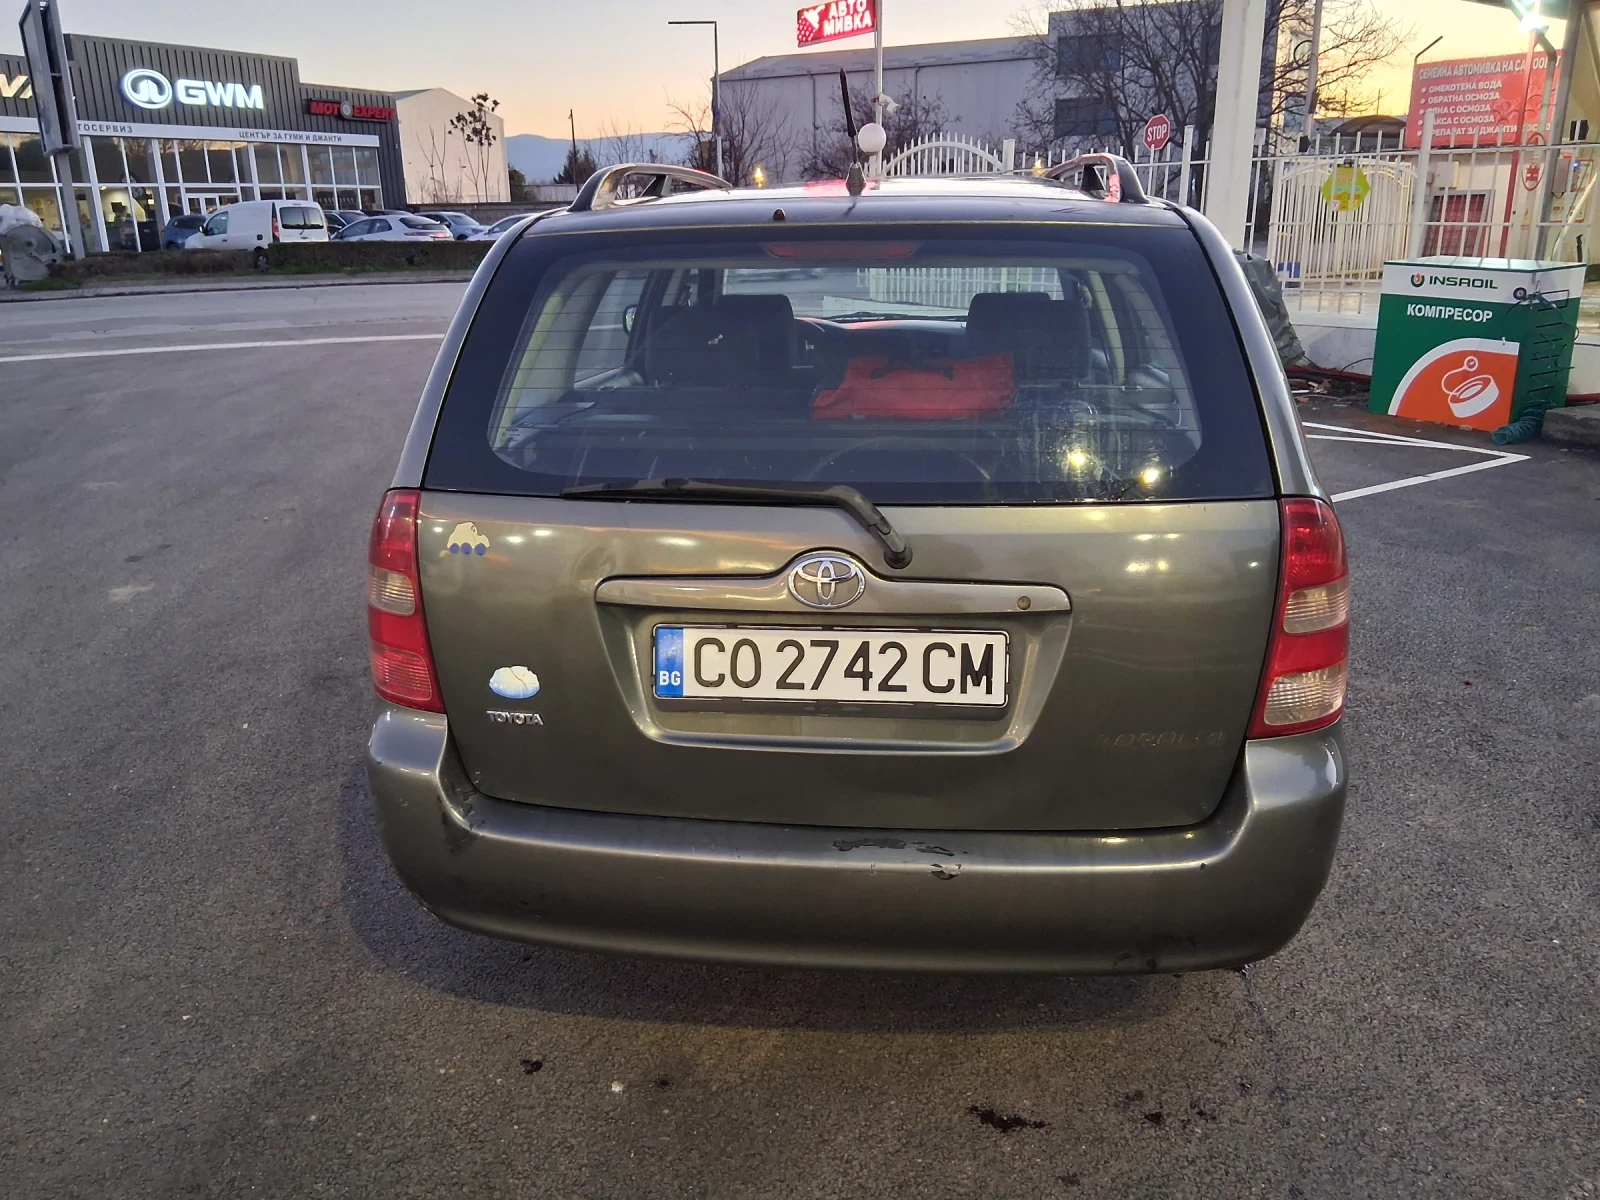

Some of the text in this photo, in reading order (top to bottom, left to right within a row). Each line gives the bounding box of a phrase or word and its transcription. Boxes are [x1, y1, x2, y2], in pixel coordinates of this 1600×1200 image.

[829, 0, 867, 19] АВТО
[823, 10, 872, 36] МИВКА
[1453, 61, 1501, 77] АВТОМИВКА
[1501, 60, 1514, 72] НА
[177, 79, 264, 109] GWM
[1429, 80, 1502, 93] ОМЕКОТЕНА ВОДА
[1428, 92, 1500, 104] ОБРАТНА ОСМОЗА
[1456, 104, 1491, 113] ОСМОЗА
[77, 123, 132, 133] ТОСЕРВИЗ
[1433, 115, 1495, 125] АКСА С ОСМОЗА
[239, 131, 271, 139] ЦЕНТЪР
[273, 132, 283, 140] ЗА
[284, 133, 303, 141] ГУМИ
[312, 134, 342, 143] ДЖАНТИ
[1147, 124, 1167, 141] STOP
[1407, 303, 1493, 322] КОМПРЕСОР
[694, 637, 994, 695] CO 2742 CM
[659, 671, 681, 685] BG
[486, 710, 544, 726] TOYOTA
